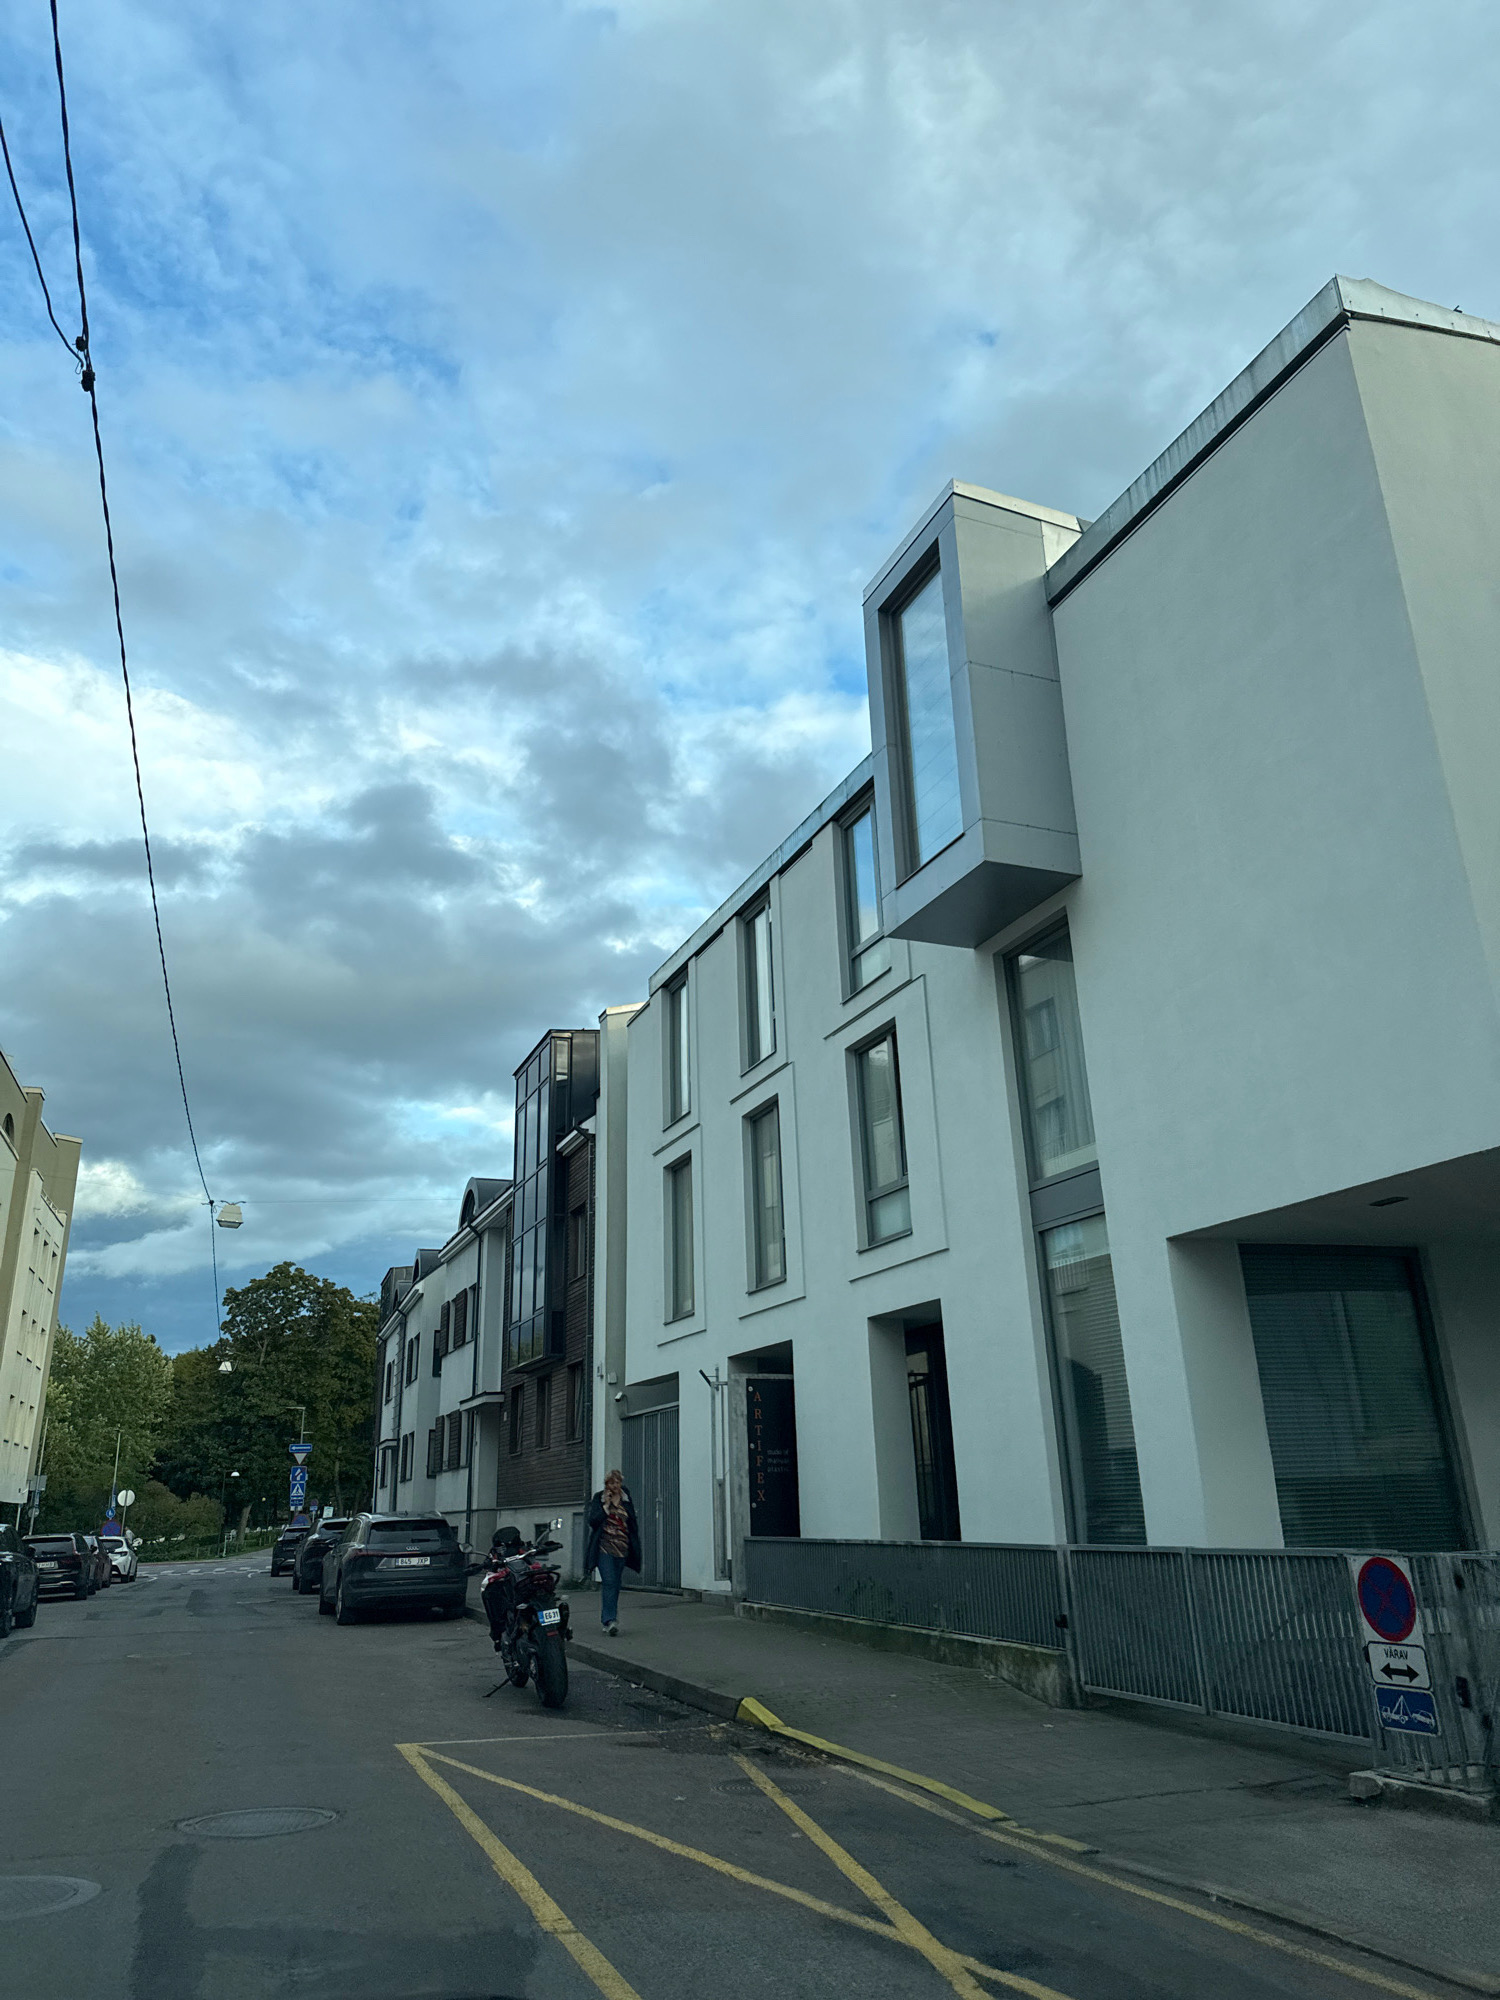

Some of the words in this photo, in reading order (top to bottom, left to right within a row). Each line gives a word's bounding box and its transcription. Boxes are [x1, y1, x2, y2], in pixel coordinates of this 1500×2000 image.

[754, 1392, 765, 1501] ARTIFEX
[416, 1557, 429, 1565] JXP
[1384, 1646, 1408, 1660] VÄRAV
